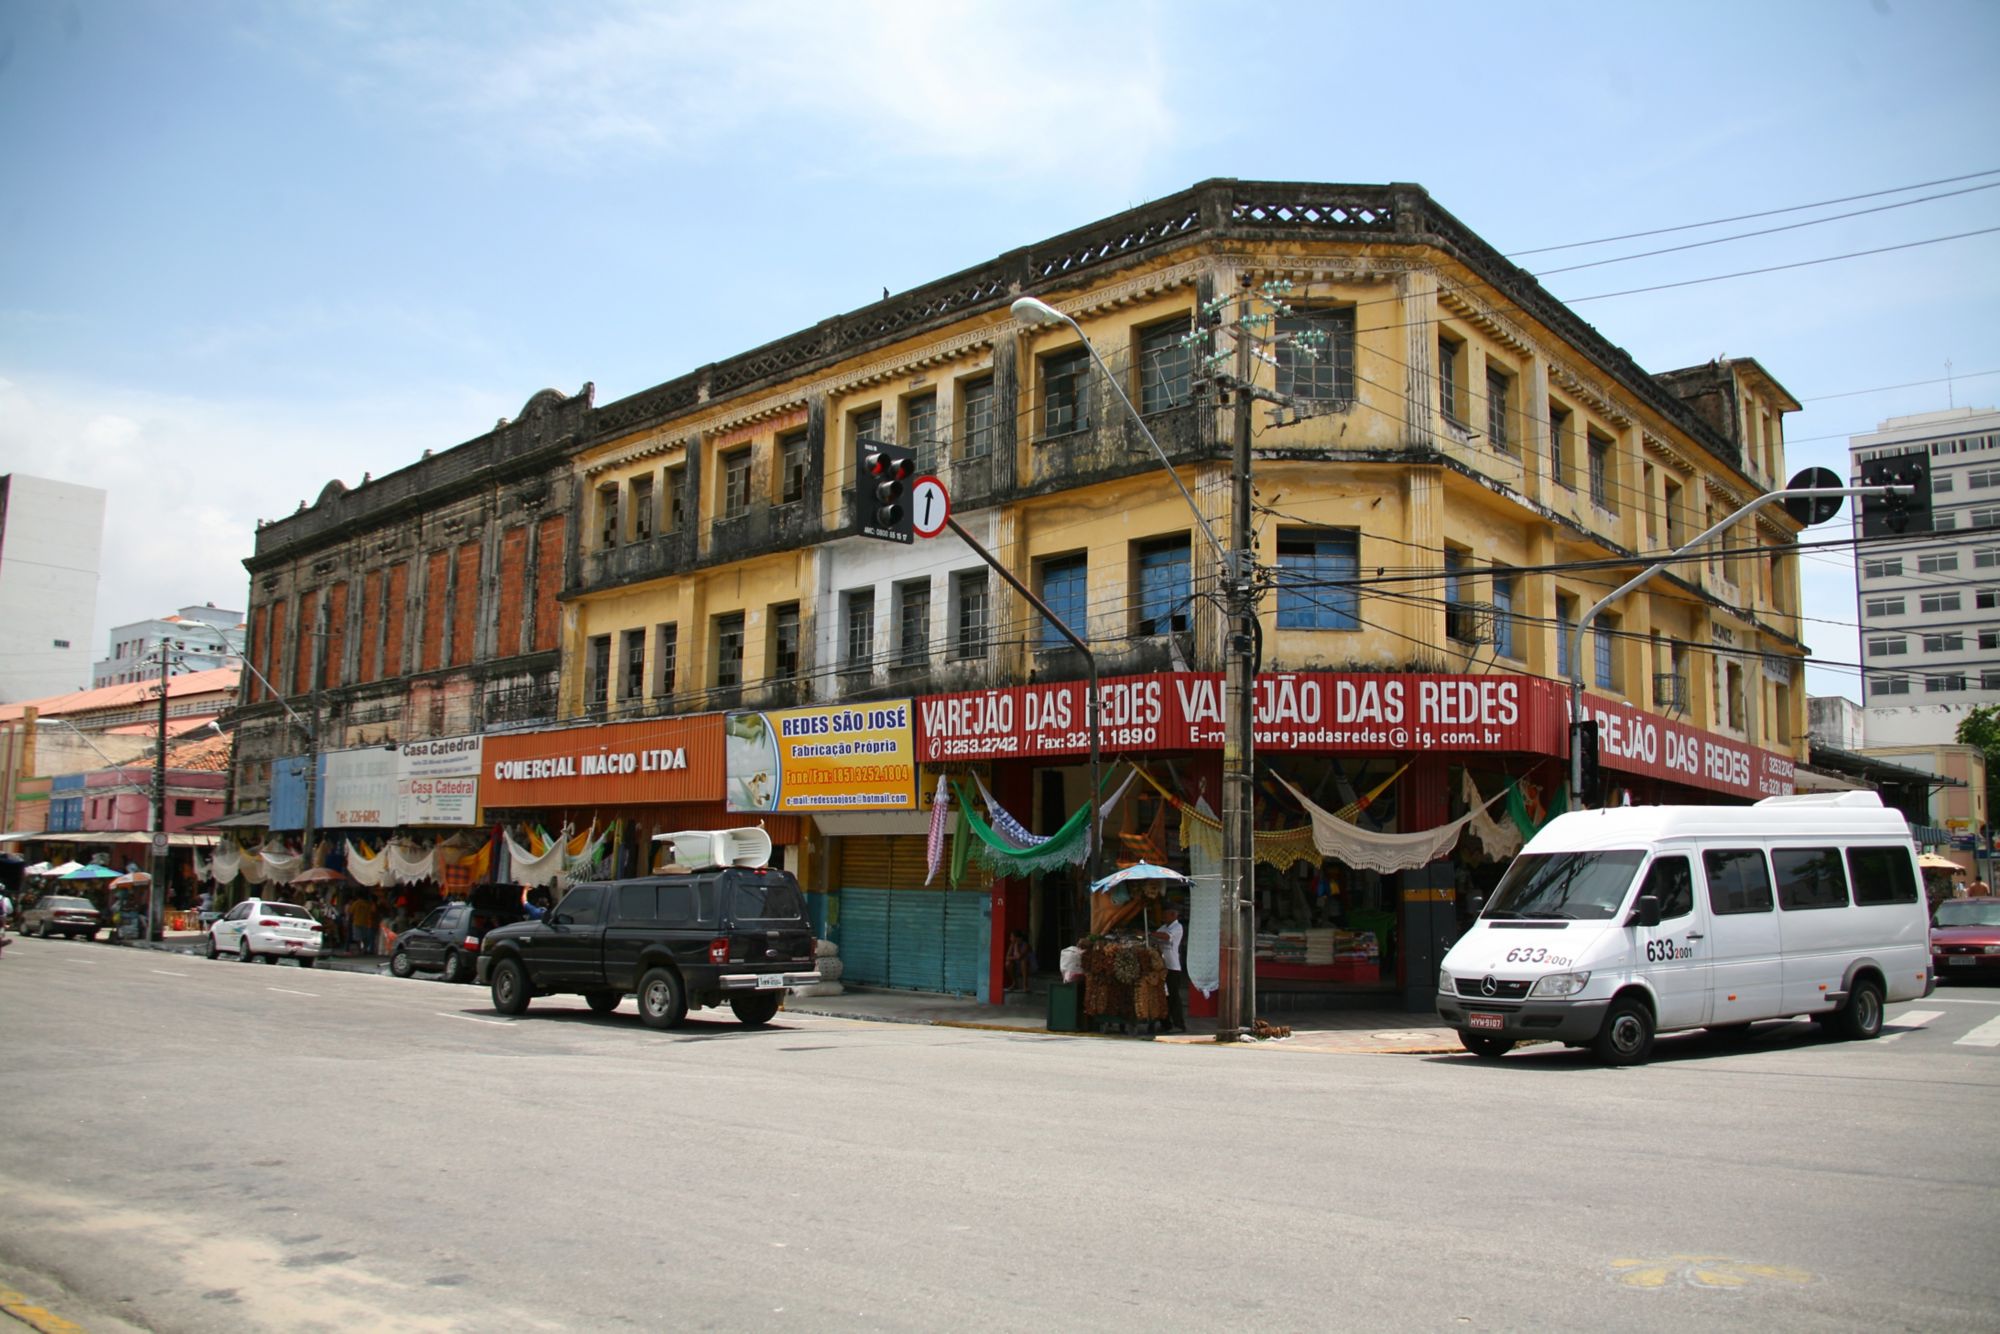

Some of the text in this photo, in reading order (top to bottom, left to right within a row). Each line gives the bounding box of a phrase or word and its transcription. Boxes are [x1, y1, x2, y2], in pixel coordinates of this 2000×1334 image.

[1176, 675, 1518, 725] VAJÃO DAS REDES
[782, 706, 906, 736] REDES SÃO JOSÉ
[921, 690, 1014, 737] VAREJÃO
[1025, 688, 1073, 731] DAS
[403, 737, 479, 756] Casa Catedral
[792, 740, 897, 757] Fabricação Própria
[944, 736, 1018, 755] 3253.2742
[1037, 733, 1064, 750] Fax:
[495, 757, 576, 780] COMERCIAL
[581, 747, 637, 776] INÁCIO
[642, 748, 687, 771] LTDA
[1666, 730, 1698, 775] DAS
[1705, 742, 1750, 787] REDES
[786, 769, 833, 785] Fone/Fax:
[833, 767, 855, 784] (85)
[856, 765, 908, 782] 3252.1804
[411, 780, 475, 794] Casa Catedral
[1506, 947, 1573, 967] 633 2001
[1647, 939, 1692, 962] 633 2001
